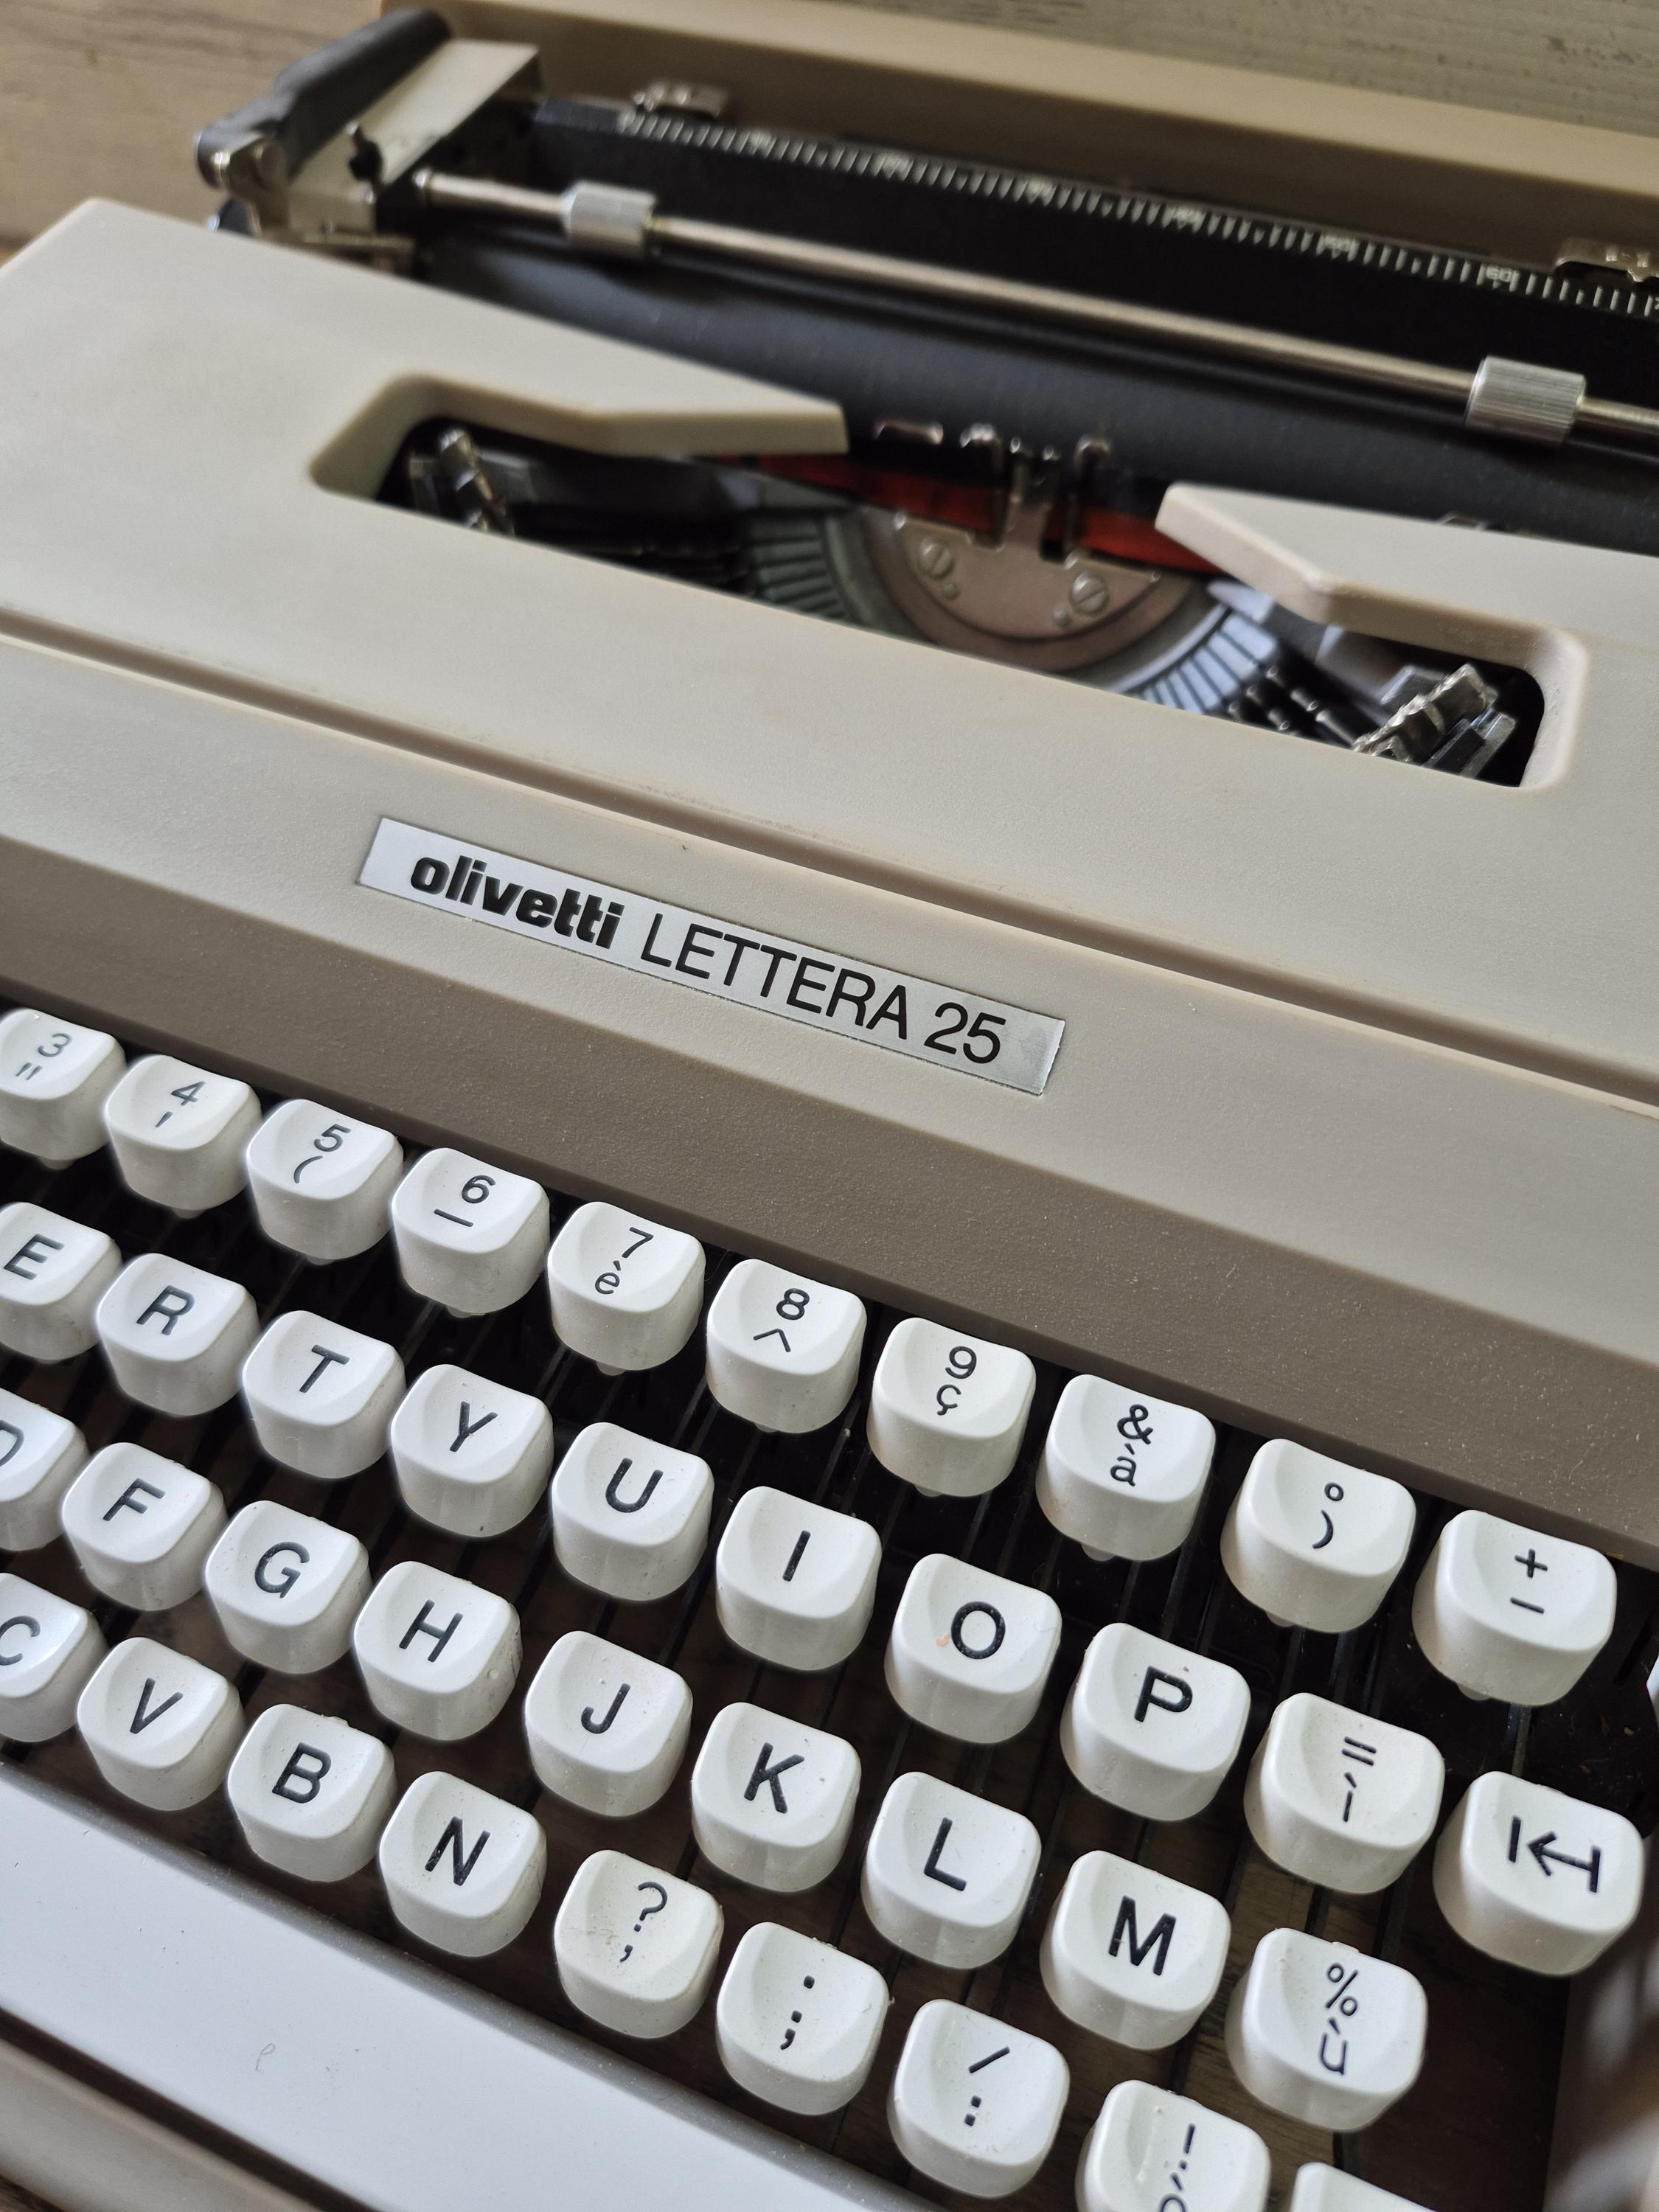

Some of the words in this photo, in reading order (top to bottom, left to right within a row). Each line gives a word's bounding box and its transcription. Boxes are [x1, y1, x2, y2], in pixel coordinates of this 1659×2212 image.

[410, 855, 625, 950] olivetti
[639, 913, 908, 1040] LETTERA
[923, 1001, 1006, 1065] 25
[36, 1032, 71, 1058] 3
[170, 1081, 204, 1106] 4
[313, 1124, 351, 1152] 5
[293, 1155, 323, 1184] (
[461, 1175, 496, 1204] 6
[3, 1234, 61, 1280] E
[621, 1226, 654, 1259] 7
[594, 1260, 622, 1295] è
[136, 1285, 193, 1335] R
[776, 1287, 810, 1321] 8
[299, 1344, 349, 1394] T
[945, 1346, 977, 1380] 9
[936, 1384, 961, 1416] ç
[449, 1401, 498, 1453] Y
[1116, 1404, 1154, 1445] &
[605, 1458, 664, 1514] U
[1110, 1443, 1137, 1487] à
[102, 1478, 164, 1522] F
[1312, 1510, 1334, 1550] )
[254, 1542, 310, 1599] G
[782, 1530, 811, 1582] I
[1514, 1549, 1548, 1579] +
[0, 1615, 41, 1666] C
[398, 1599, 463, 1663] H
[950, 1601, 1006, 1660] O
[129, 1677, 183, 1735] V
[580, 1683, 631, 1735] J
[1134, 1666, 1193, 1723] P
[271, 1742, 331, 1804] B
[1341, 1737, 1377, 1767] =
[743, 1742, 804, 1815] K
[425, 1816, 490, 1887] N
[923, 1818, 967, 1892] L
[633, 1881, 668, 1933] ?
[1107, 1896, 1177, 1977] M
[1325, 1964, 1358, 2017] %
[968, 2047, 1010, 2074] /
[964, 2096, 982, 2127] :
[1179, 2124, 1196, 2171] !
